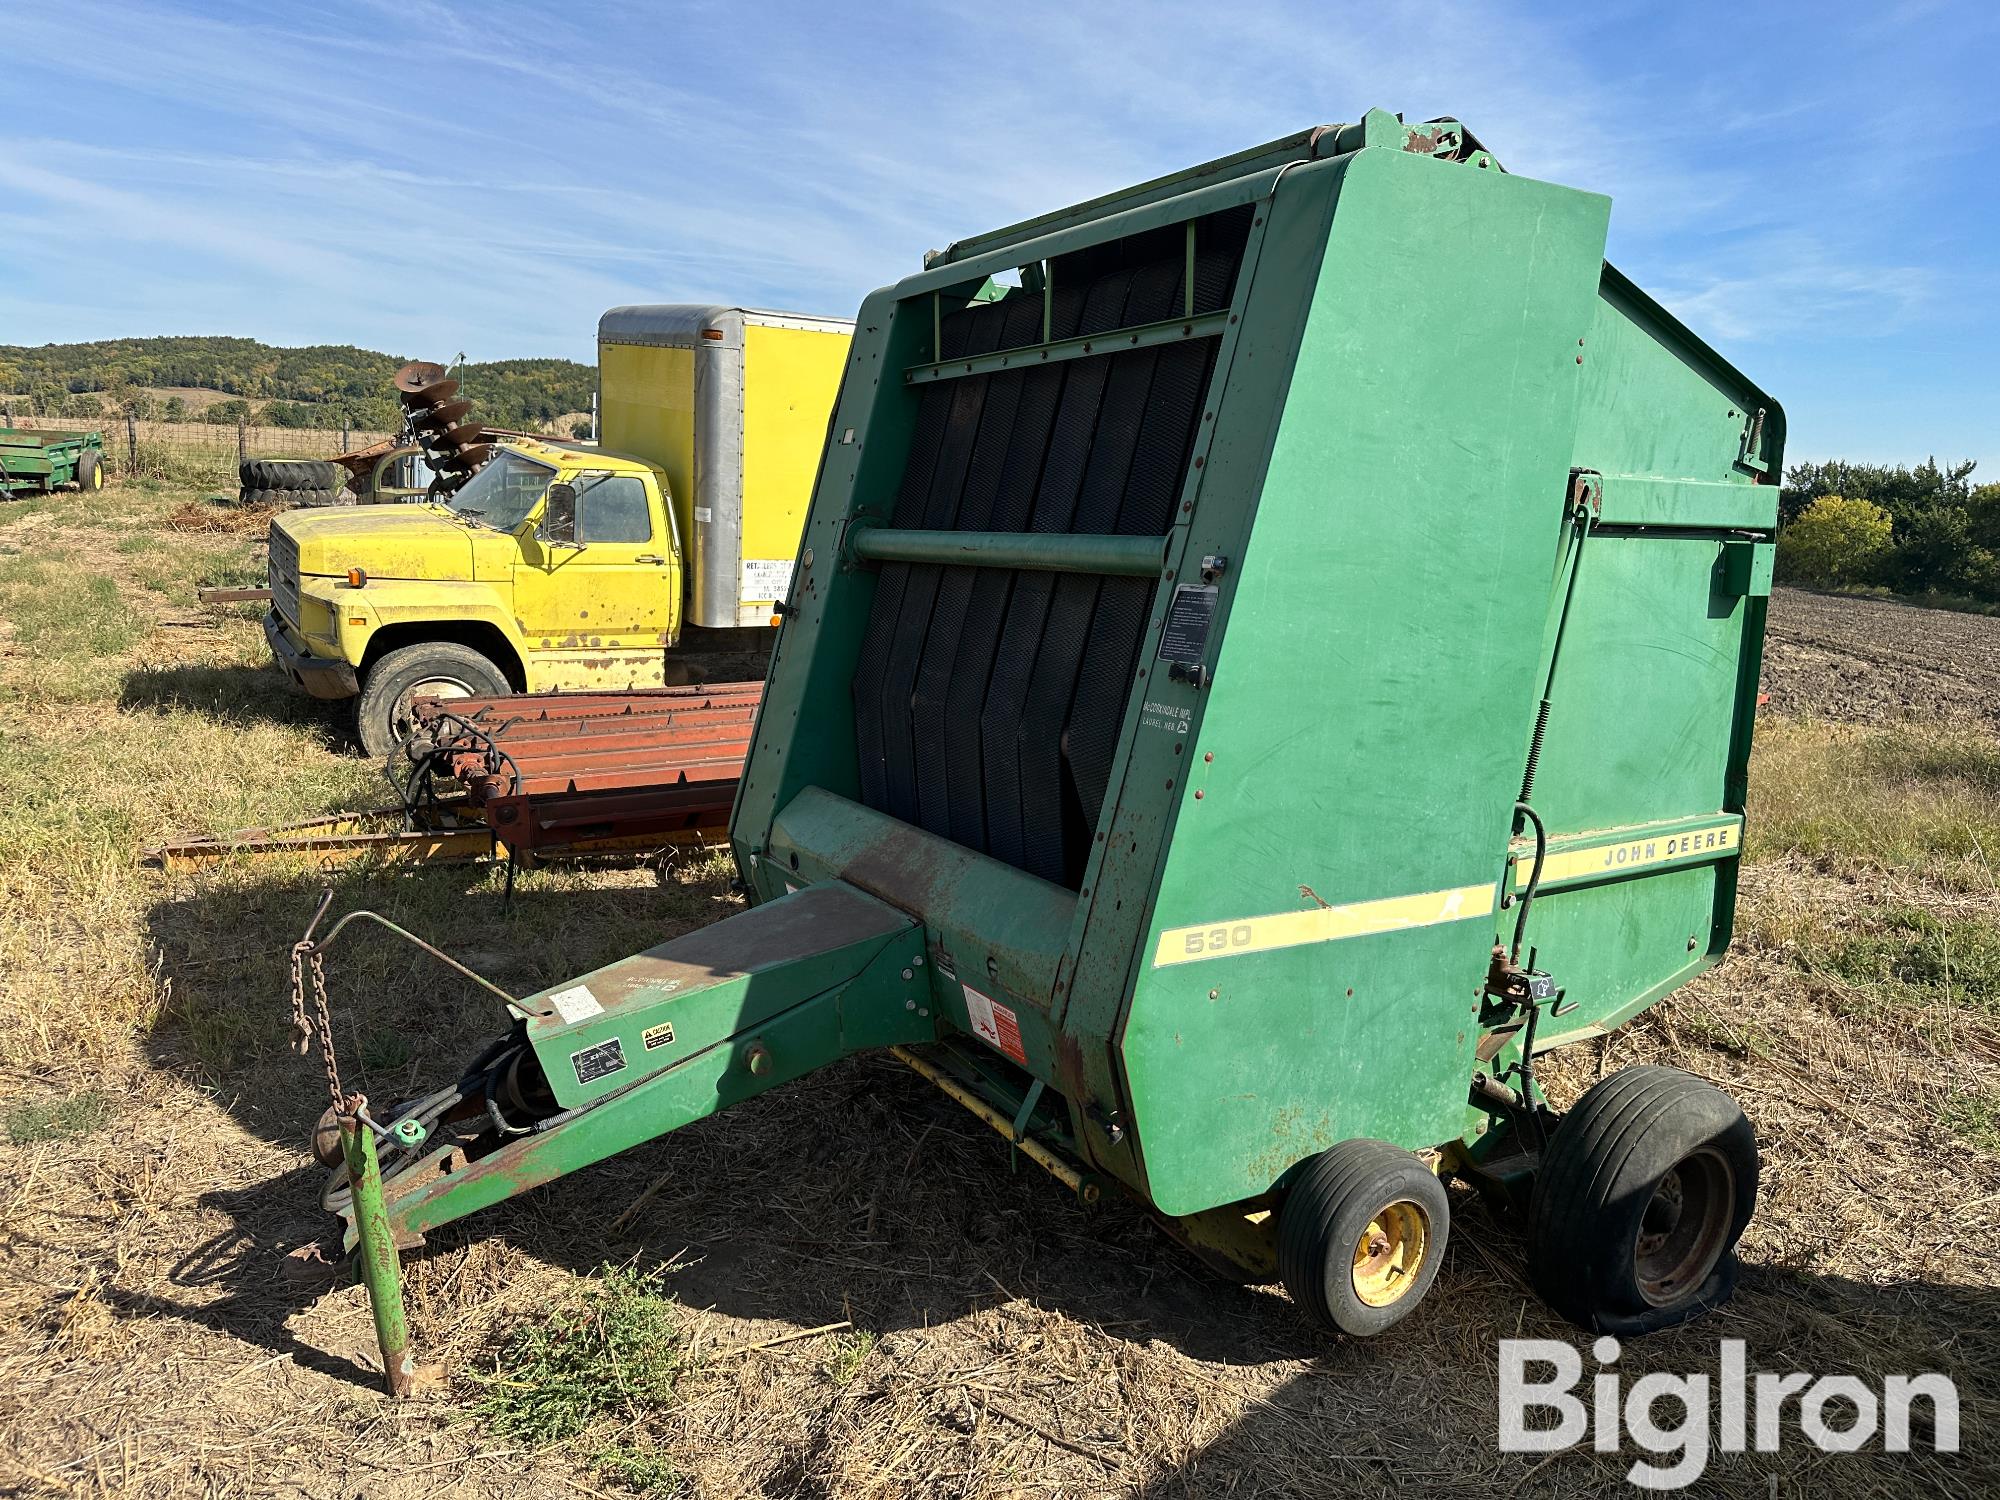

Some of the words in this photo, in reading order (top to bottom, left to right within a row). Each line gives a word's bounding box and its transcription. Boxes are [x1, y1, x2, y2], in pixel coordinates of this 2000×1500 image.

[1604, 842, 1656, 866] JOHN
[1667, 830, 1728, 855] DEERE
[1185, 925, 1252, 954] 530
